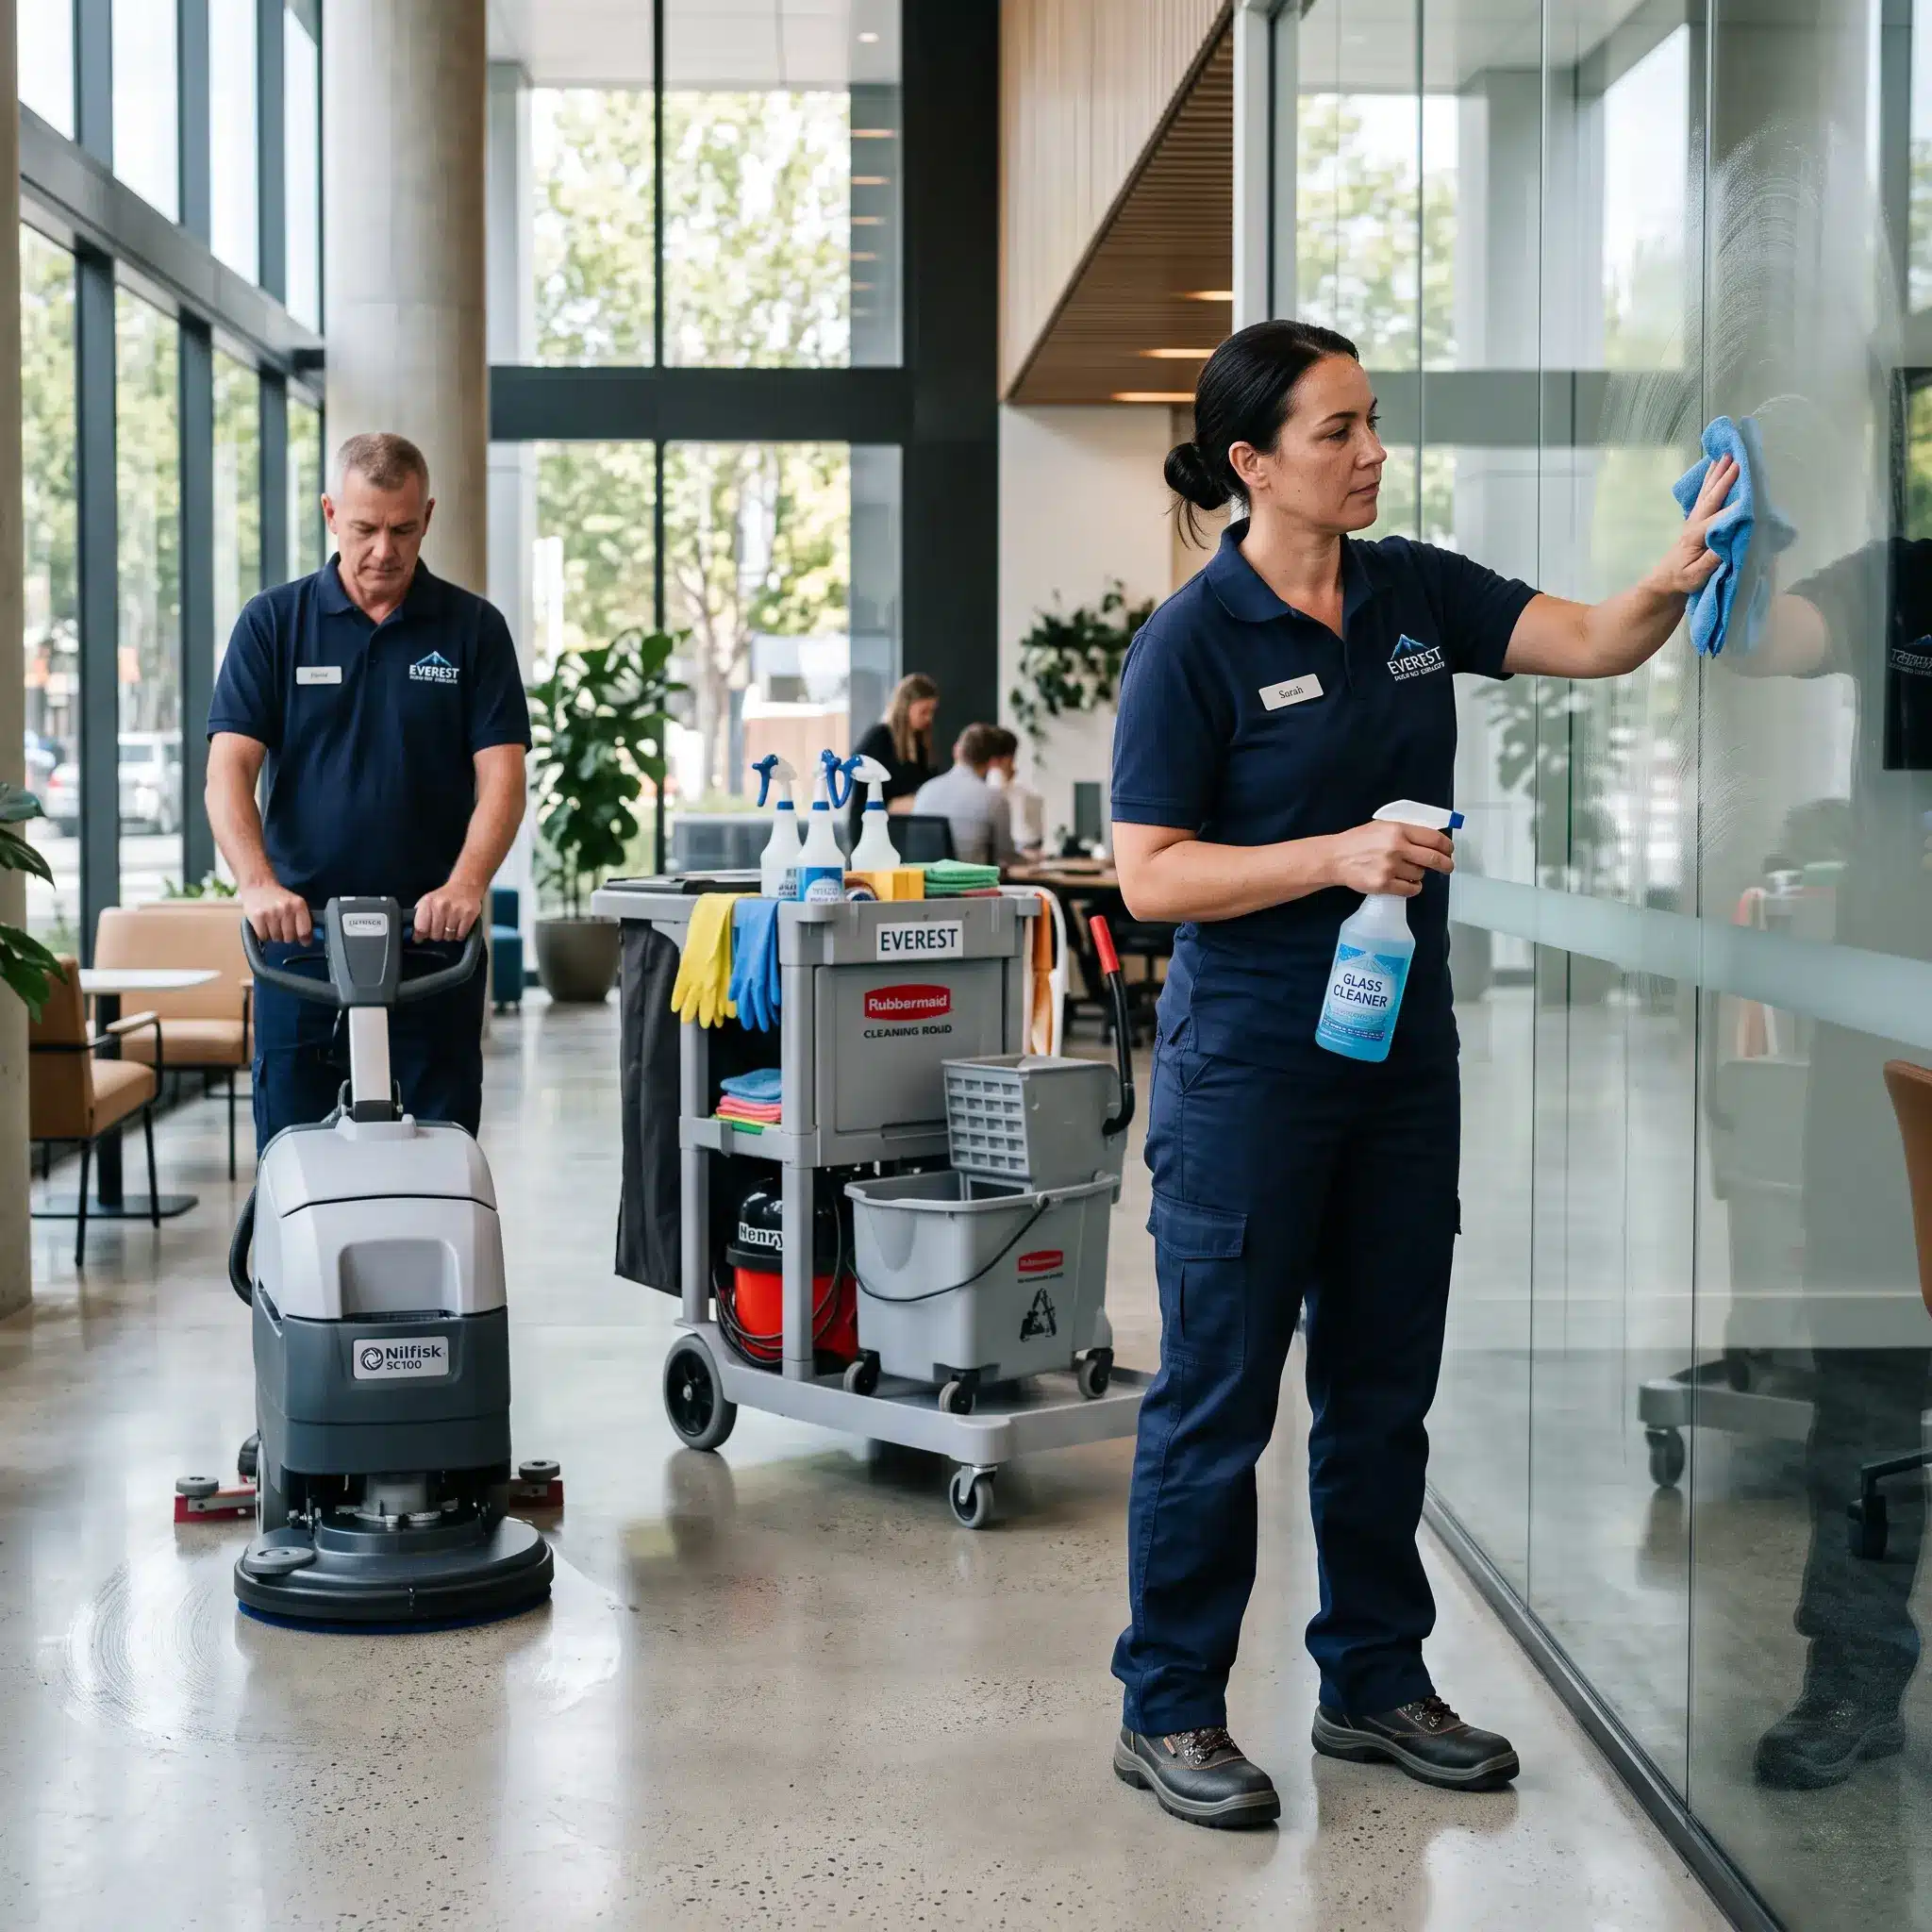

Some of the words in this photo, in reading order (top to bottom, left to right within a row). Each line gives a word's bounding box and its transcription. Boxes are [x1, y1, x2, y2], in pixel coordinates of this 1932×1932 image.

[1387, 646, 1441, 675] EVEREST
[409, 664, 459, 678] EVEREST
[880, 928, 958, 952] EVEREST
[1343, 973, 1383, 992] GLASS
[868, 994, 947, 1011] Rubbermaid
[1333, 984, 1388, 1008] CLEANER
[863, 1026, 919, 1039] CLEANING
[386, 1344, 441, 1359] Nilfisk
[386, 1360, 422, 1371] SC100
